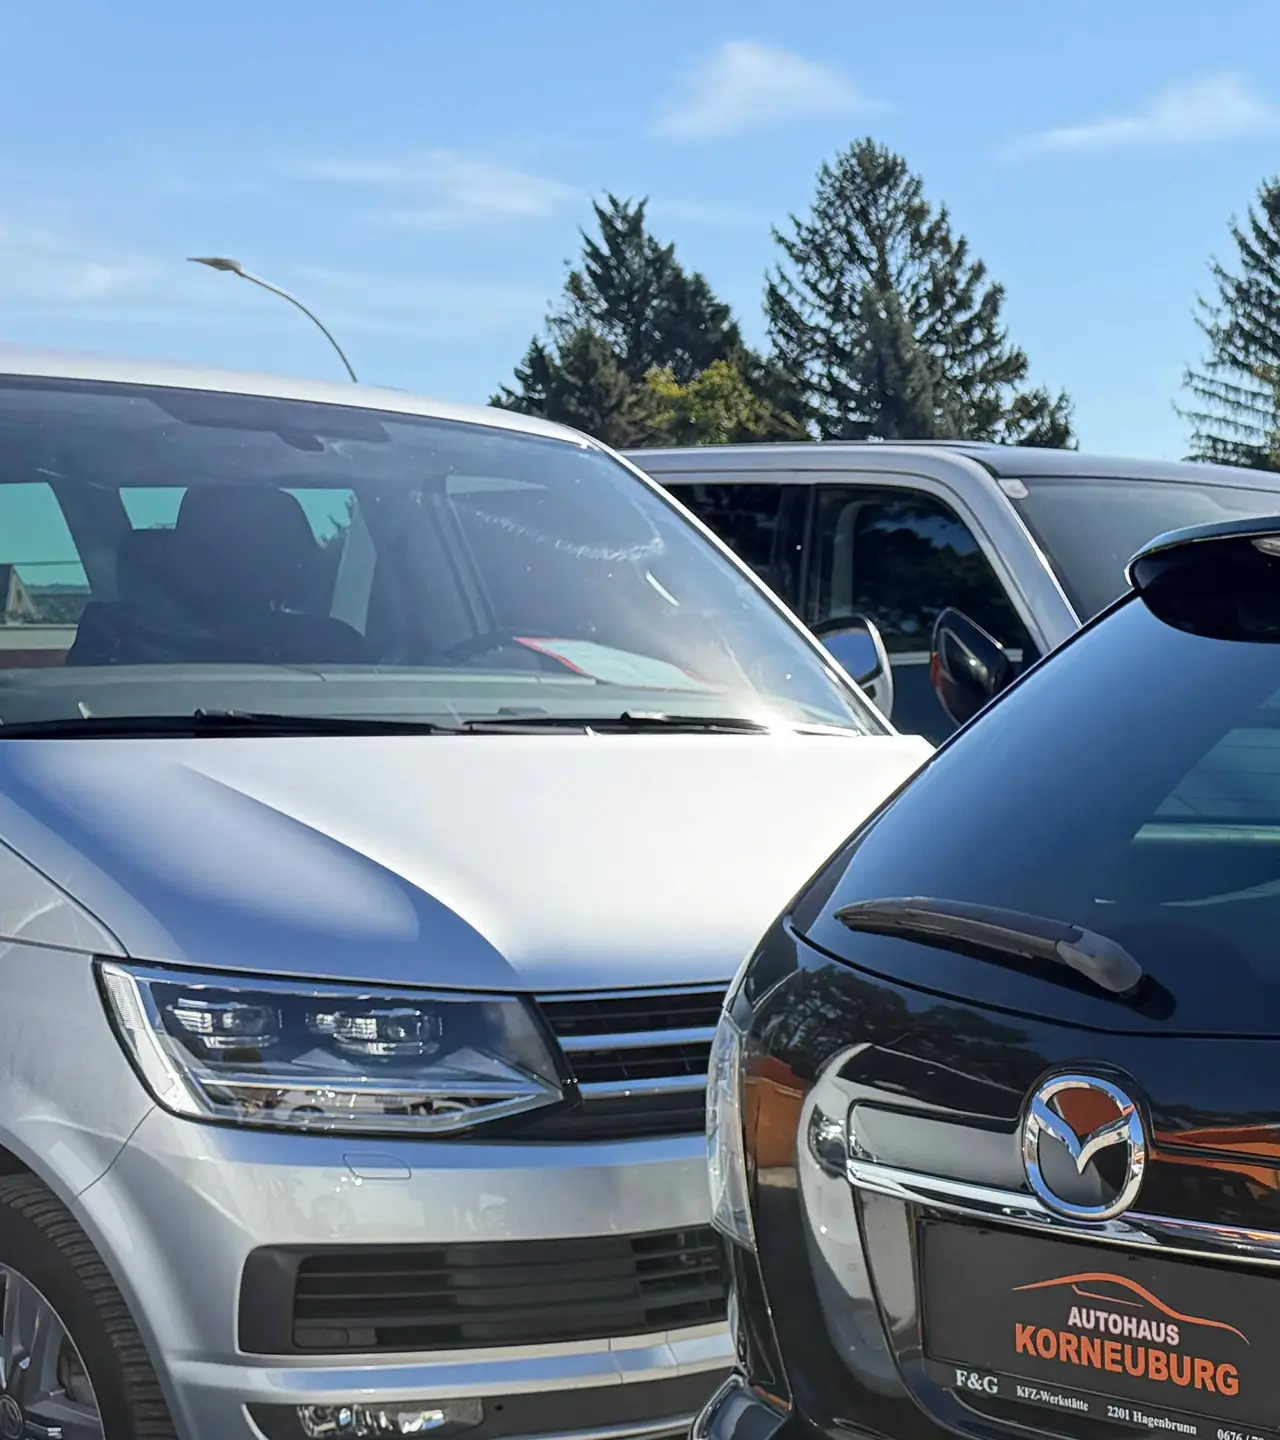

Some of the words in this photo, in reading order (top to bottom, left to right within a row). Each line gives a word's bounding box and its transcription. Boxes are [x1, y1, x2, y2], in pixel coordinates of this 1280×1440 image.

[1014, 1322, 1240, 1397] KORNEUBURG
[1067, 1305, 1181, 1346] AUTOHAUS
[954, 1368, 999, 1395] F&G
[1015, 1384, 1090, 1413] KFZ-Werkstätte
[1106, 1404, 1130, 1421] 2201
[1132, 1410, 1198, 1436] Hagenbrunn
